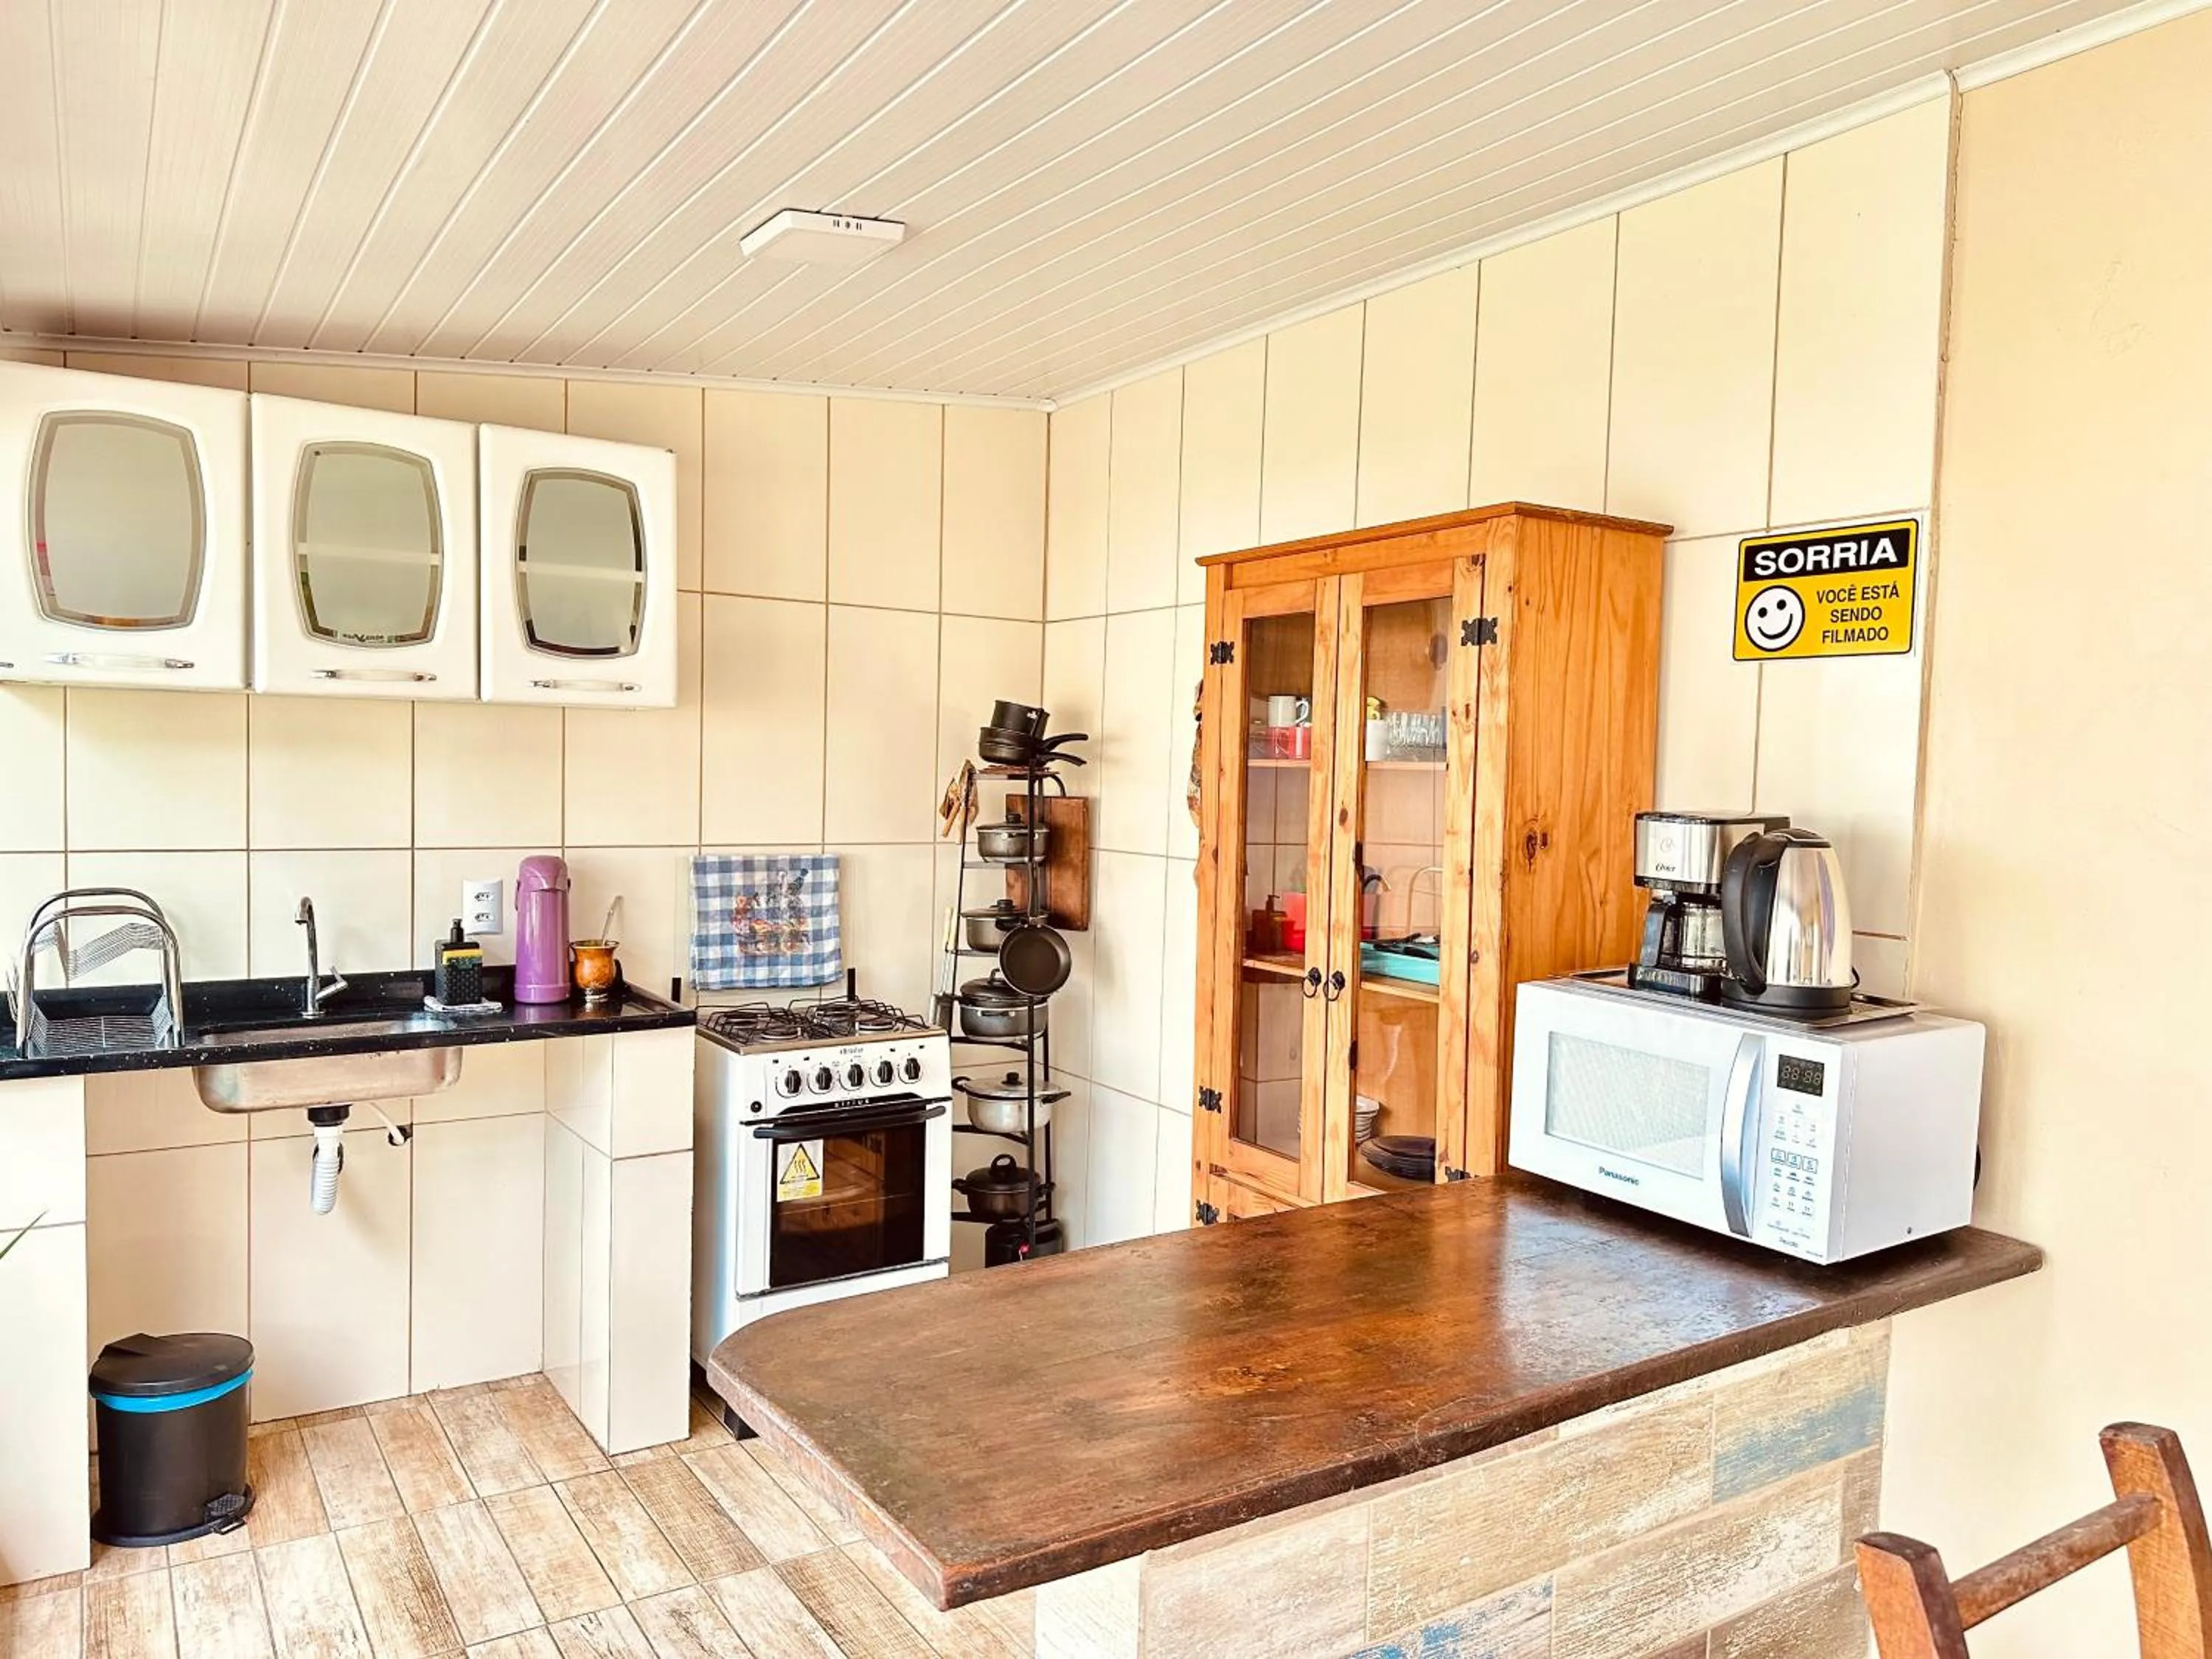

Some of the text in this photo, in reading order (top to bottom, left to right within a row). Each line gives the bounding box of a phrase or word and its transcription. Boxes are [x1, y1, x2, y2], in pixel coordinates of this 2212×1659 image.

[1754, 538, 1898, 576] SORRIA
[1816, 580, 1900, 604] VOCÊ ESTÁ
[1829, 606, 1882, 623] SENDO
[1821, 626, 1889, 644] FILMADO
